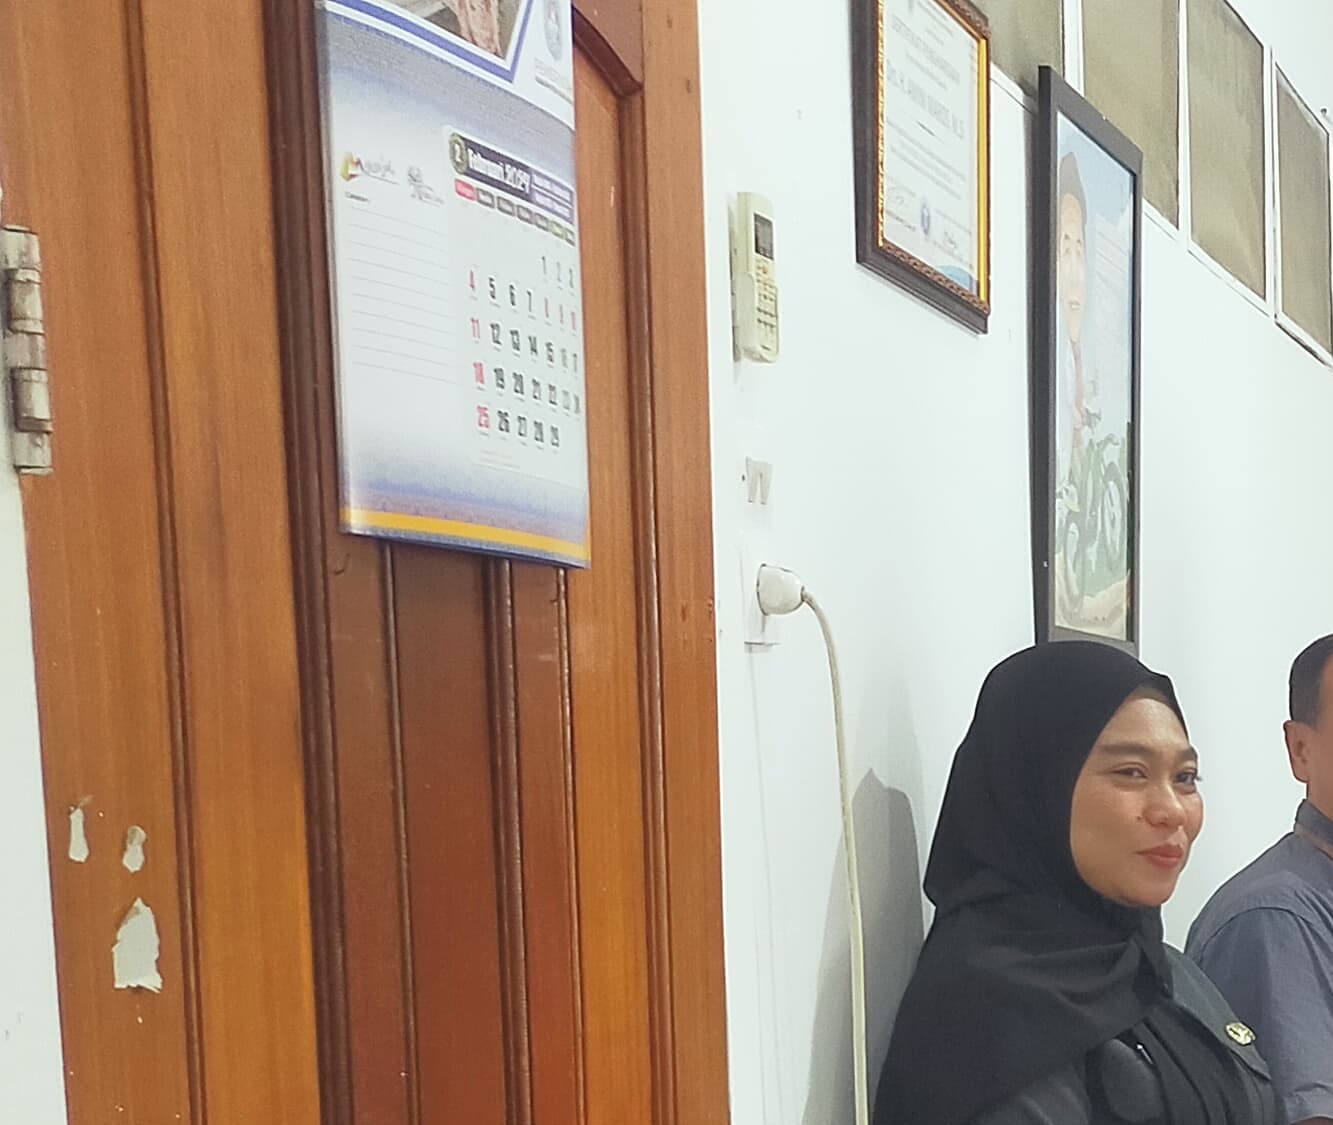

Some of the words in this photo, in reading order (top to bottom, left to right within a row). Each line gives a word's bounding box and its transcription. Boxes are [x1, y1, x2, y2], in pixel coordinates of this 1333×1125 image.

[488, 276, 497, 300] 5
[489, 322, 502, 345] 12
[476, 405, 491, 429] 25
[497, 410, 510, 433] 26
